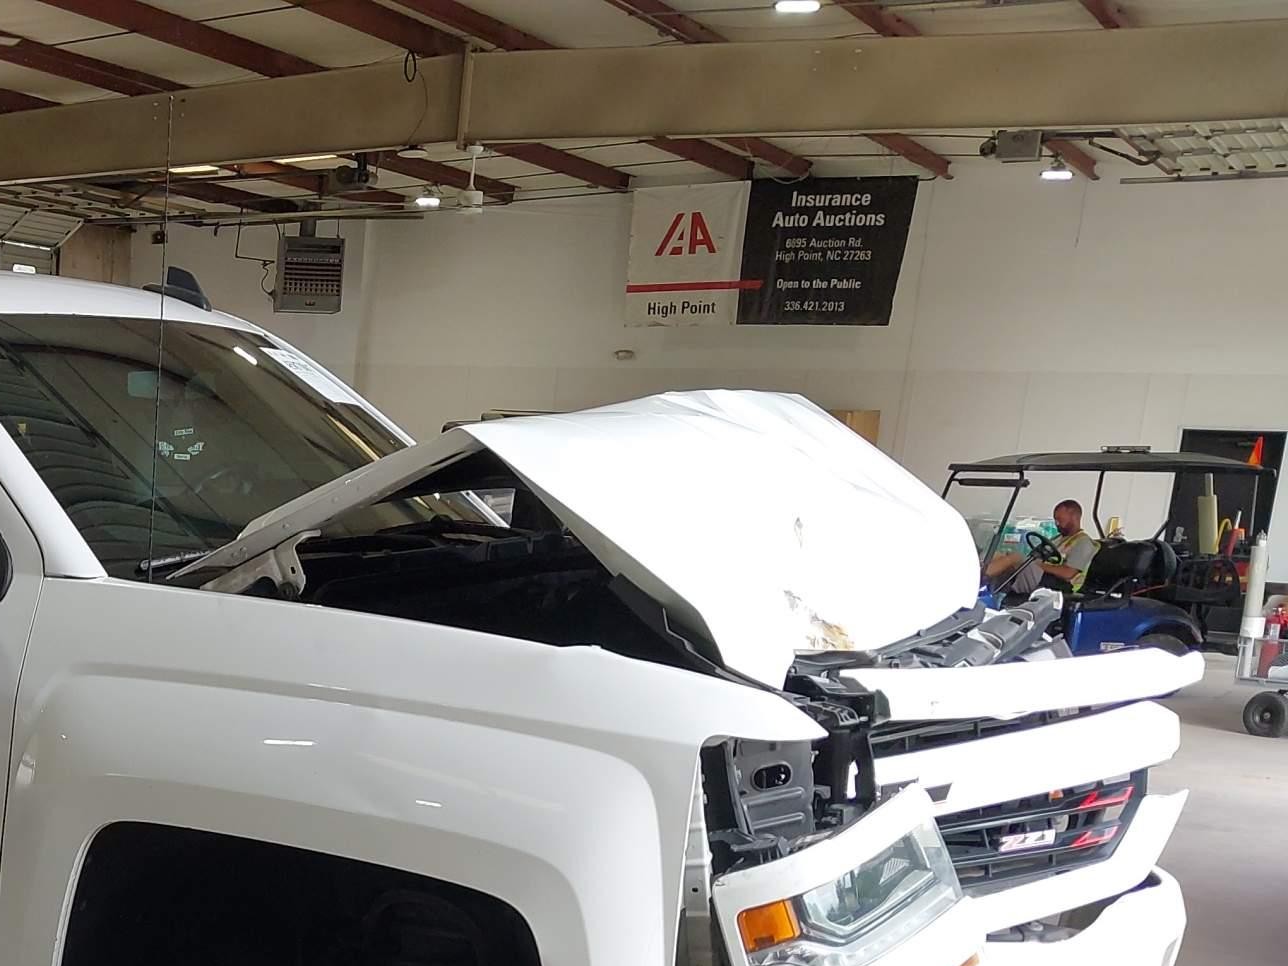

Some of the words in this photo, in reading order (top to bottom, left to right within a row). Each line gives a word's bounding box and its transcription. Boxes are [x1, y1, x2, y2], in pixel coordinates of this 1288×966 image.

[791, 191, 871, 207] Insurance
[772, 211, 808, 227] Auto
[812, 210, 885, 226] Auctions
[809, 237, 845, 248] Auction
[848, 237, 863, 247] Rd.
[775, 251, 795, 262] High
[798, 250, 824, 262] Point,
[826, 251, 841, 261] NC
[843, 250, 871, 261] 27263
[776, 279, 799, 291] Open
[801, 280, 810, 289] to
[812, 279, 828, 289] the
[830, 278, 861, 289] Public
[647, 302, 677, 318] High
[681, 300, 716, 314] Point
[784, 301, 844, 312] 336.421.2013
[999, 828, 1055, 852] Z71
